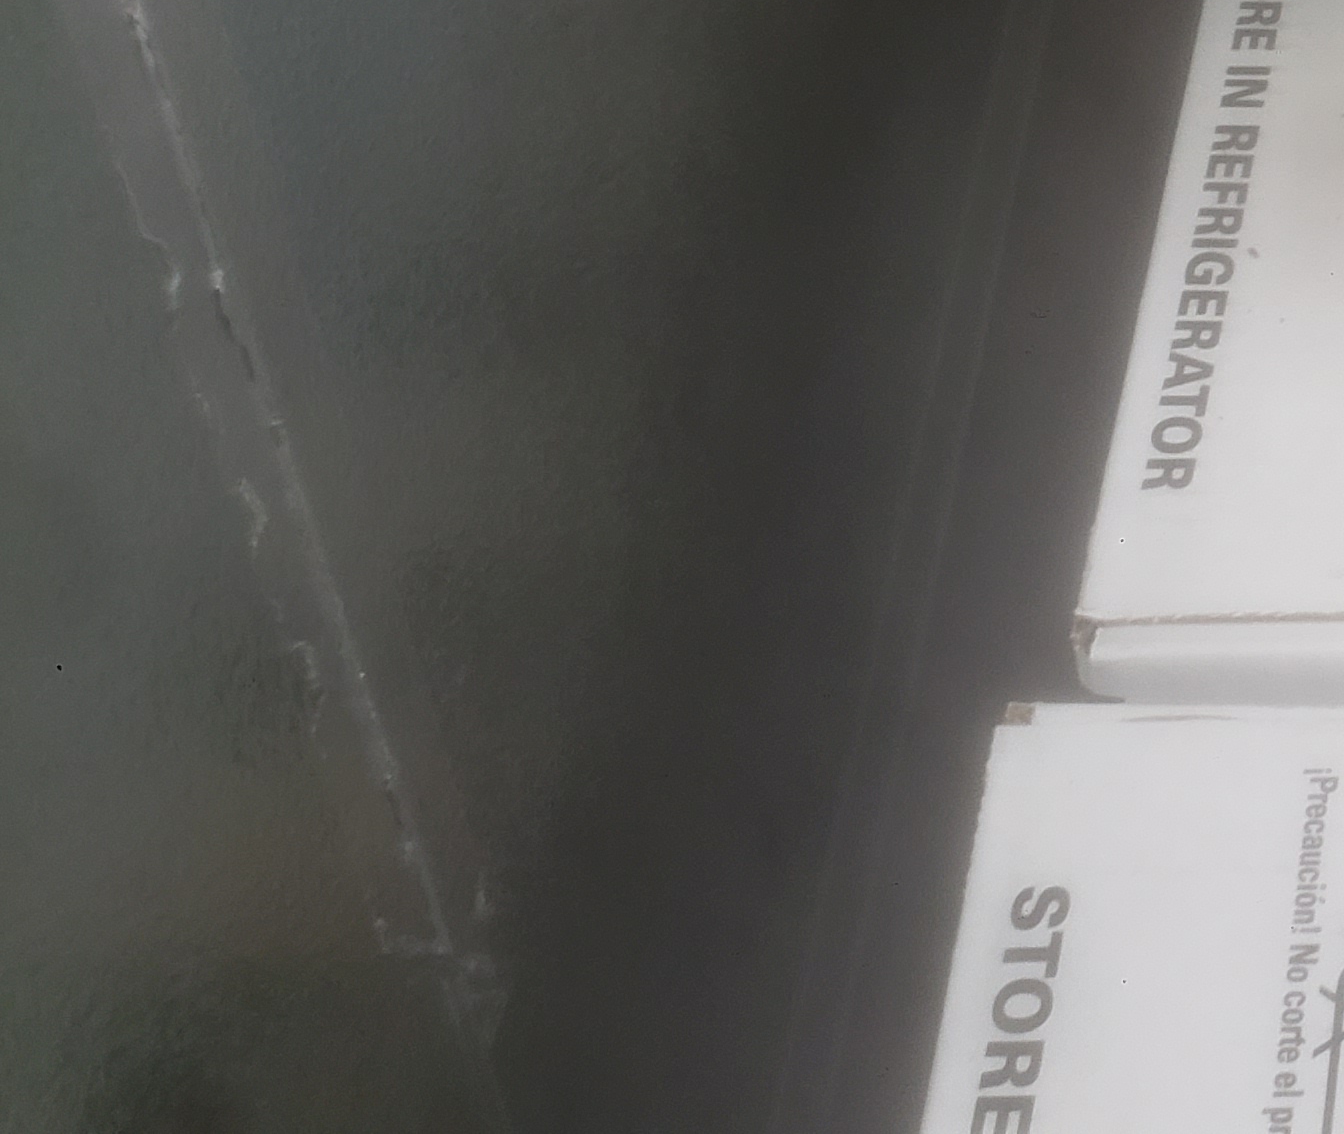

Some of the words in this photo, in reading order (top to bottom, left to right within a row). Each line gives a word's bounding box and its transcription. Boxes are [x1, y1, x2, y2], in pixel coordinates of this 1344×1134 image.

[1220, 67, 1267, 109] IN
[1141, 124, 1261, 492] REFRIGERATOR
[1283, 942, 1321, 984] No
[969, 884, 1071, 1134] STORE
[1276, 987, 1306, 1064] corte
[1271, 1069, 1305, 1099] el
